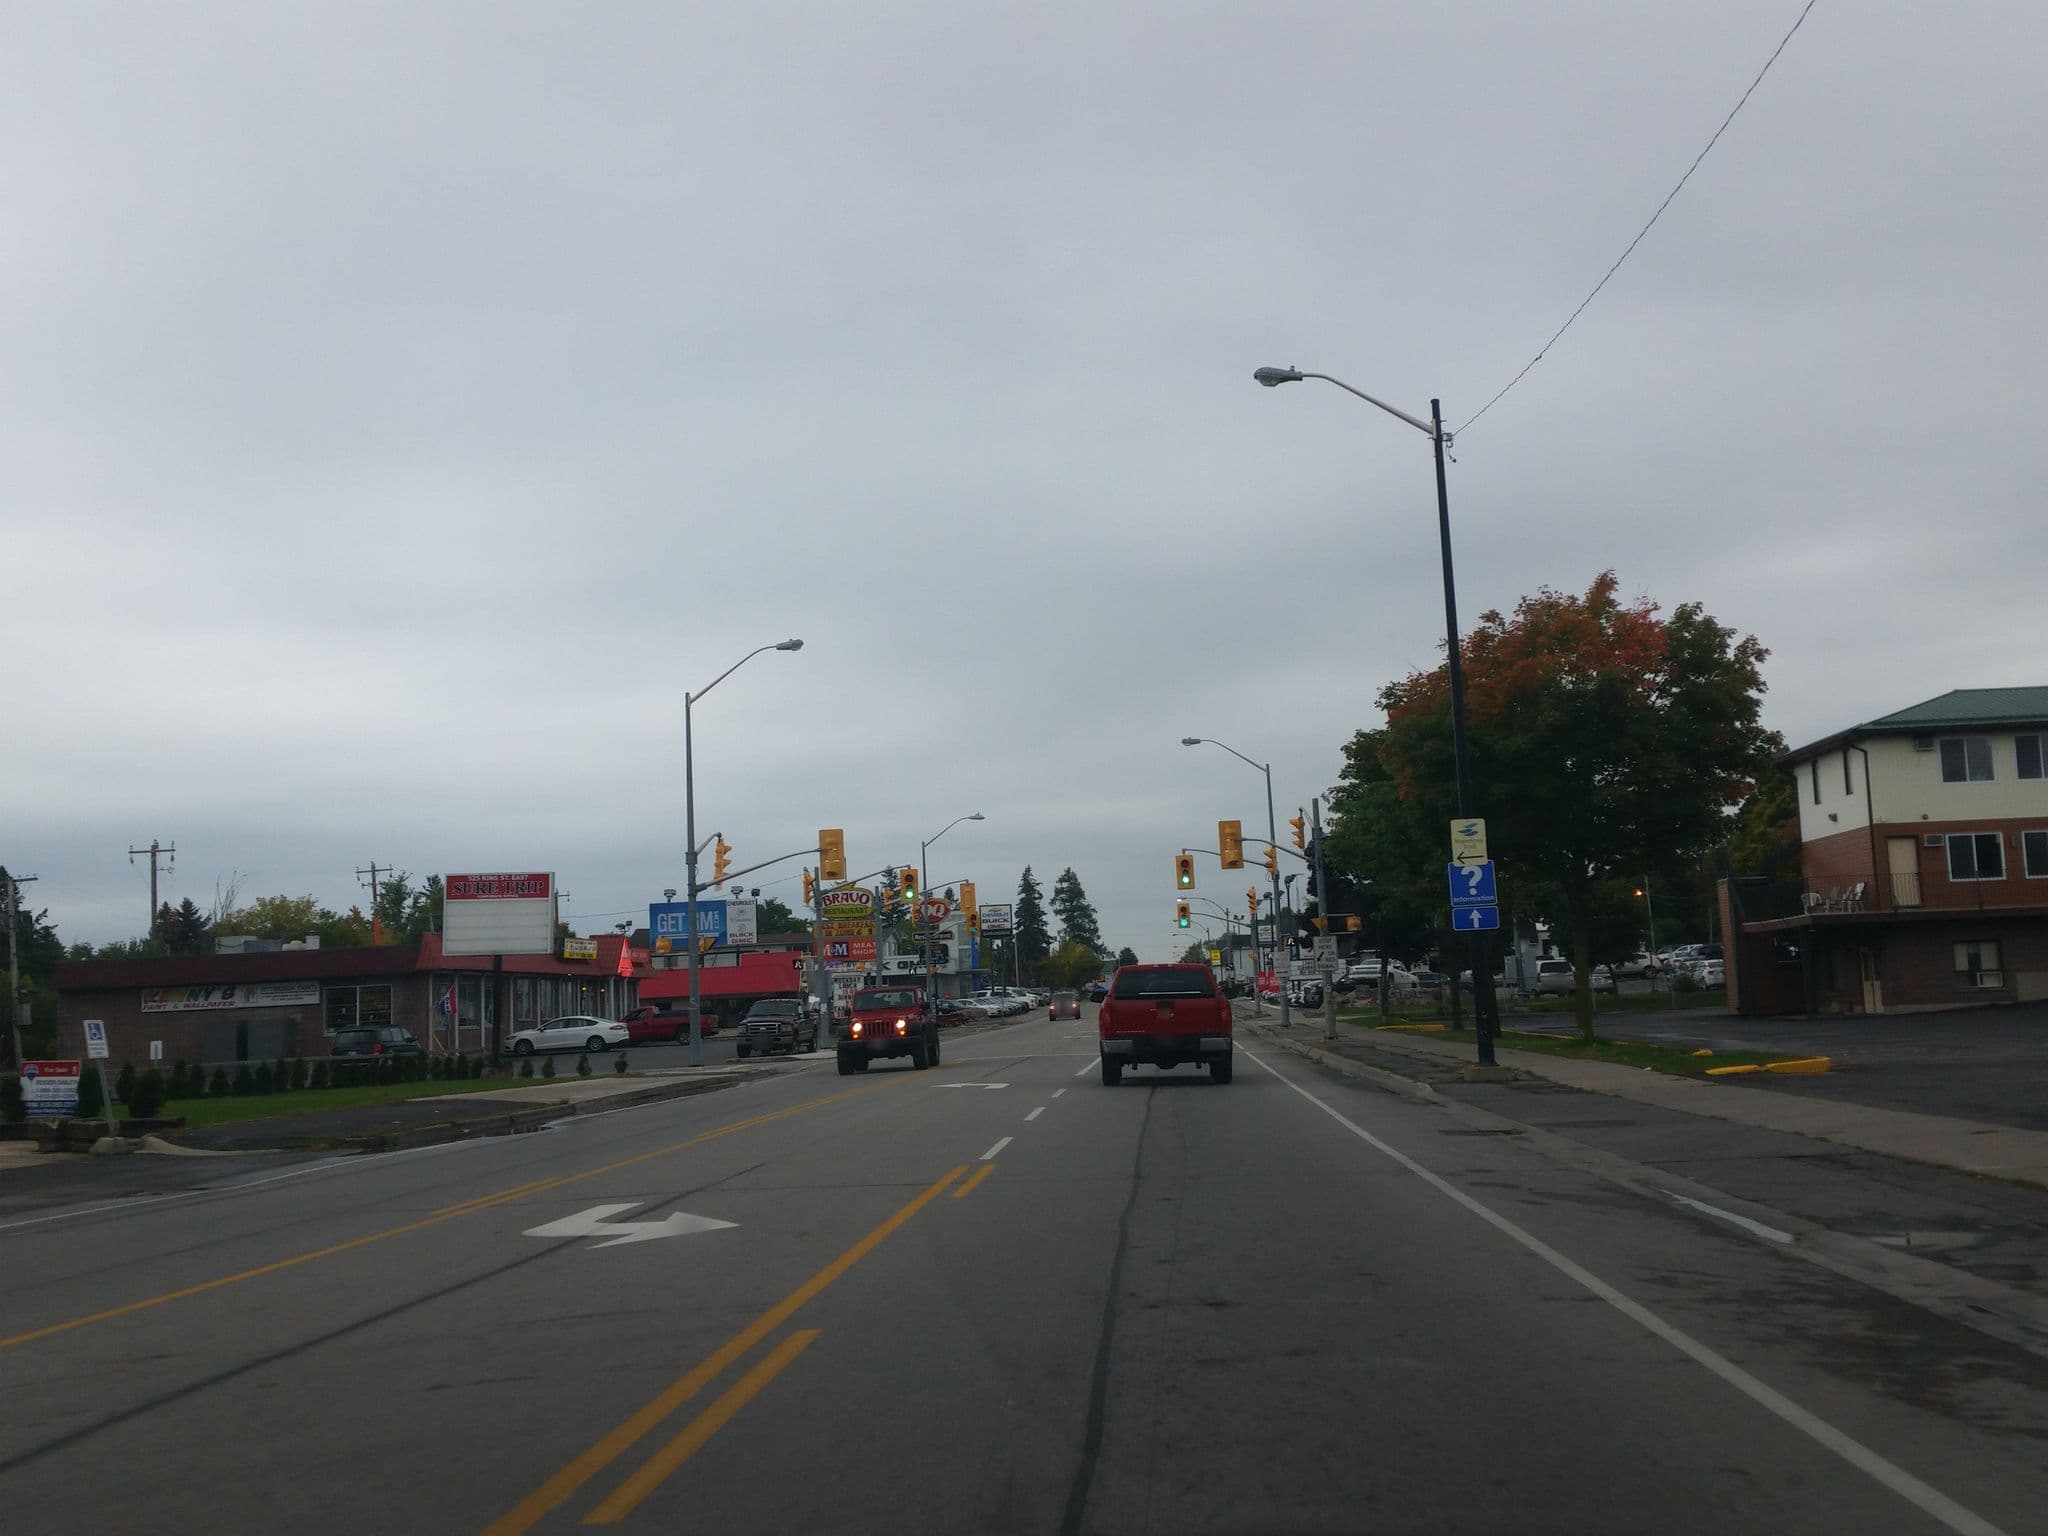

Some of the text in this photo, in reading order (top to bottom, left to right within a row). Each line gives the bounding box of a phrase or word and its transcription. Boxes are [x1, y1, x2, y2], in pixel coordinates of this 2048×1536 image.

[451, 881, 545, 896] SURE TRIP
[822, 892, 871, 907] BRAVO
[822, 907, 868, 915] RESTAURANT
[657, 911, 687, 933] GET
[853, 941, 877, 949] MEAT
